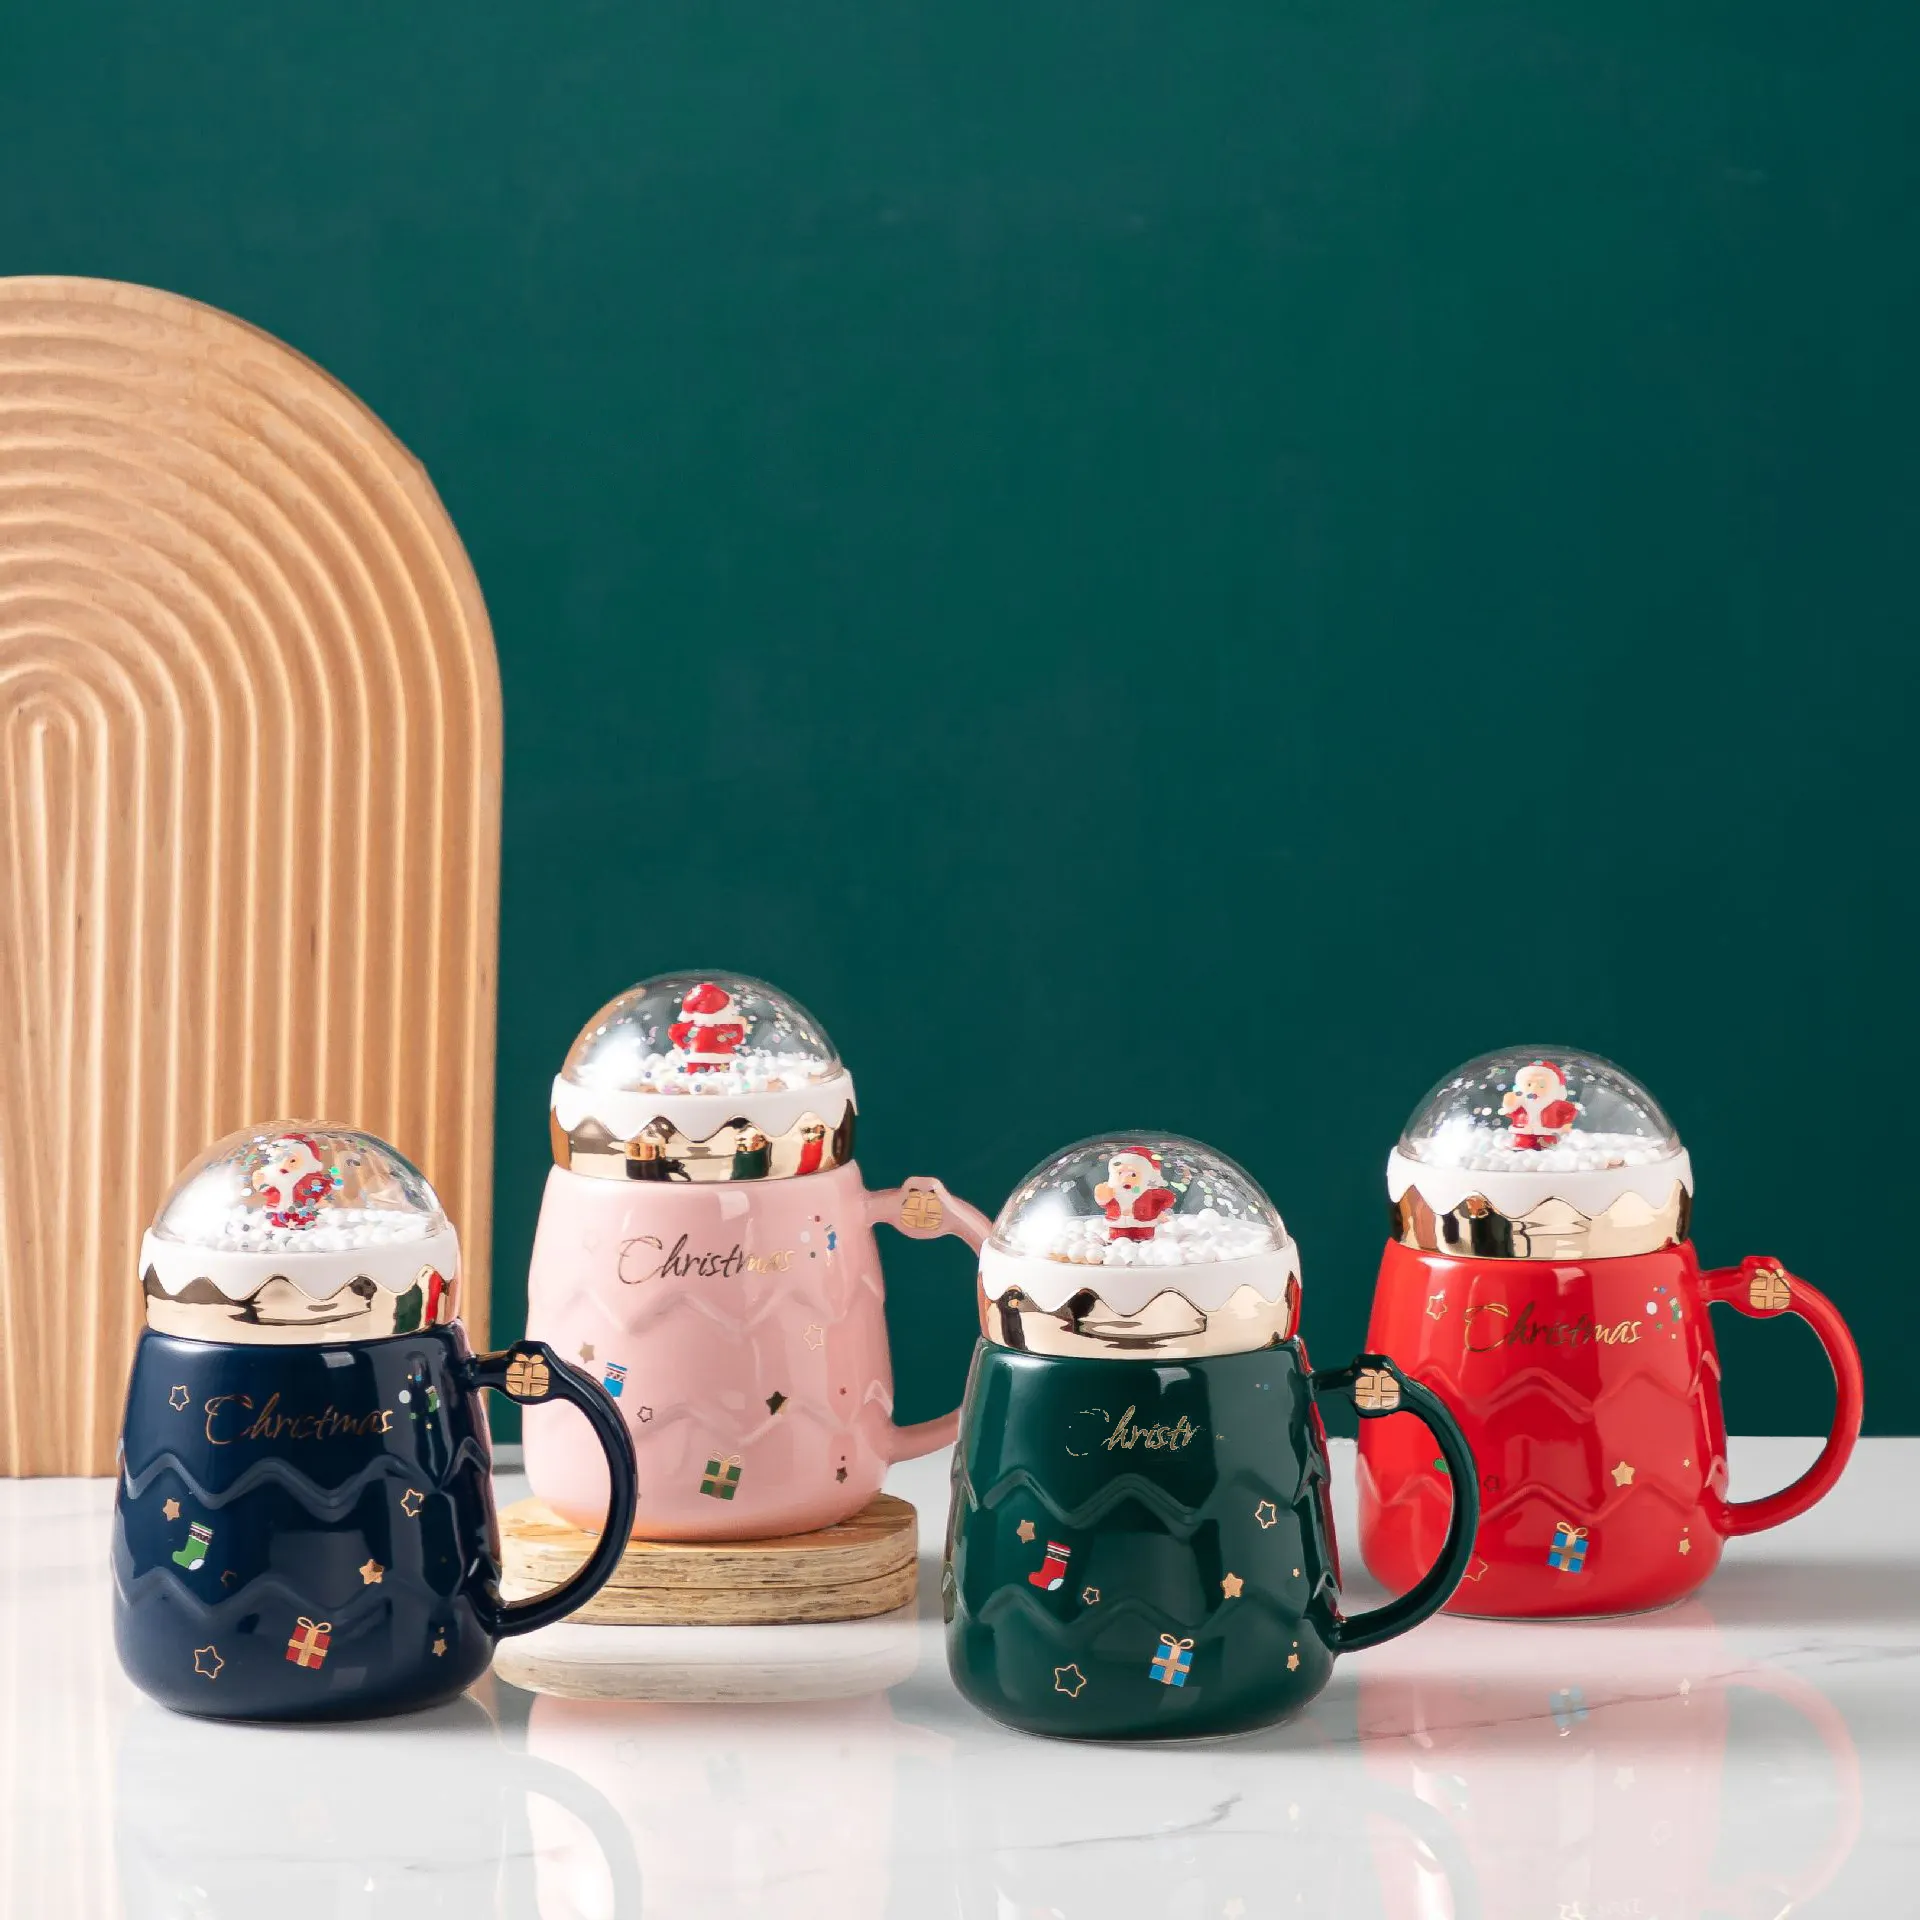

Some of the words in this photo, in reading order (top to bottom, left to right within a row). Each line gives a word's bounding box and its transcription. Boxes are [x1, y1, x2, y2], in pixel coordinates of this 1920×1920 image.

[618, 1233, 795, 1285] Christmas
[1463, 1301, 1643, 1353] Christmas
[204, 1391, 394, 1445] Christmas
